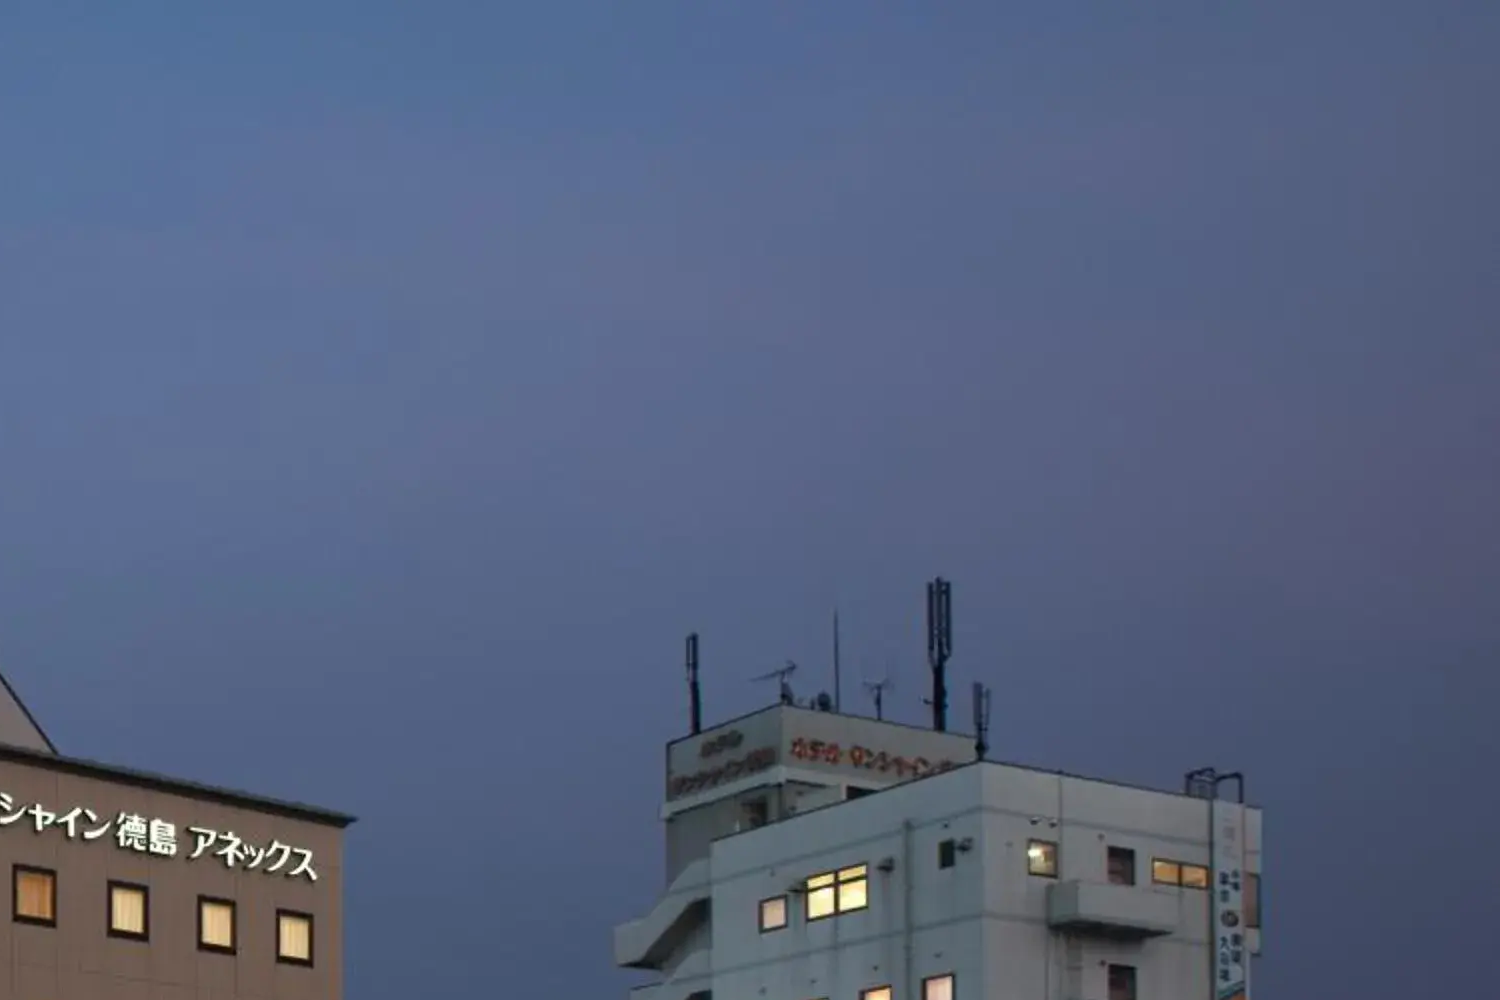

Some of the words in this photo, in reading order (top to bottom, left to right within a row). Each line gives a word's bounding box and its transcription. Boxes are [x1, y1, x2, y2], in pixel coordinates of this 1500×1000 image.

[115, 811, 179, 857] 徳島
[186, 825, 320, 881] アネックス
